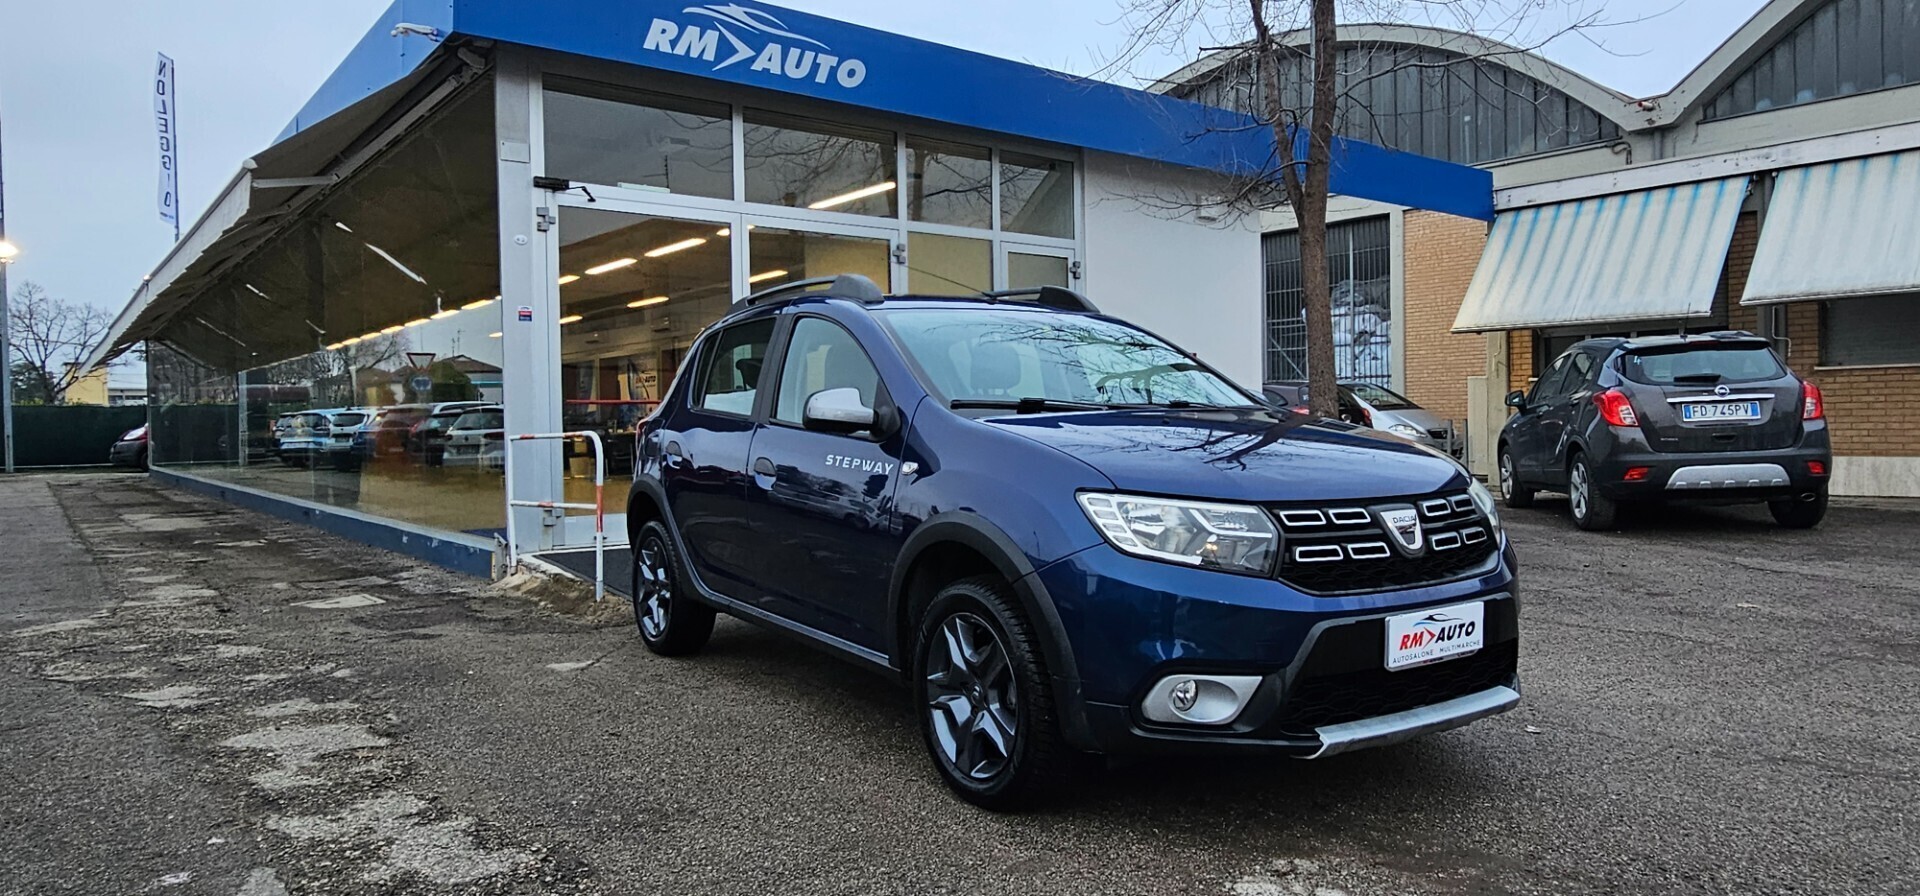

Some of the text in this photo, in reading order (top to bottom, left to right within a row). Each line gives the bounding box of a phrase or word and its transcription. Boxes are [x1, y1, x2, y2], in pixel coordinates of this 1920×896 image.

[642, 17, 867, 89] RM AUTO
[1691, 403, 1750, 417] FD 745PV
[825, 454, 894, 475] STEPWAY
[1392, 514, 1417, 524] DACIA
[1399, 621, 1476, 651] RM AUTO
[1392, 649, 1434, 664] AUTOSALONE
[1439, 640, 1481, 653] MULTIMARCHE
